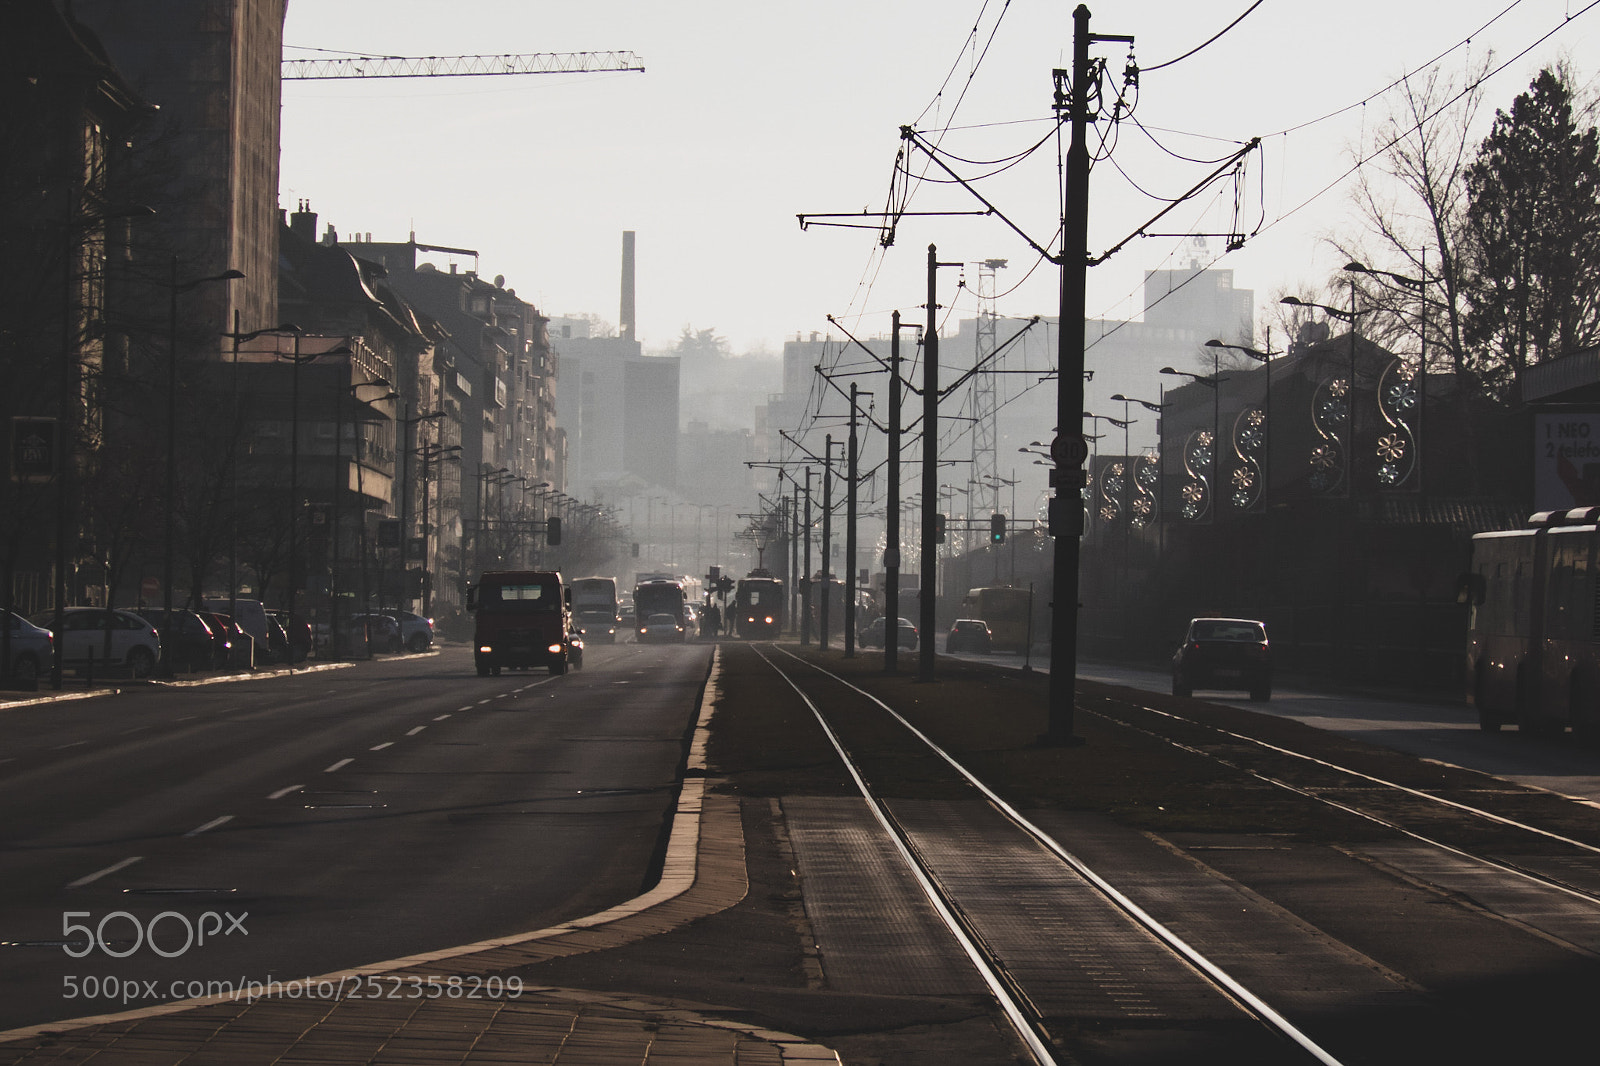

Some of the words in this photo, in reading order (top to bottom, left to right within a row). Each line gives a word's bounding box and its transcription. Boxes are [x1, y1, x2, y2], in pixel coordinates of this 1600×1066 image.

[1558, 422, 1591, 438] NEO
[1060, 441, 1079, 459] 30
[1545, 442, 1555, 458] 2
